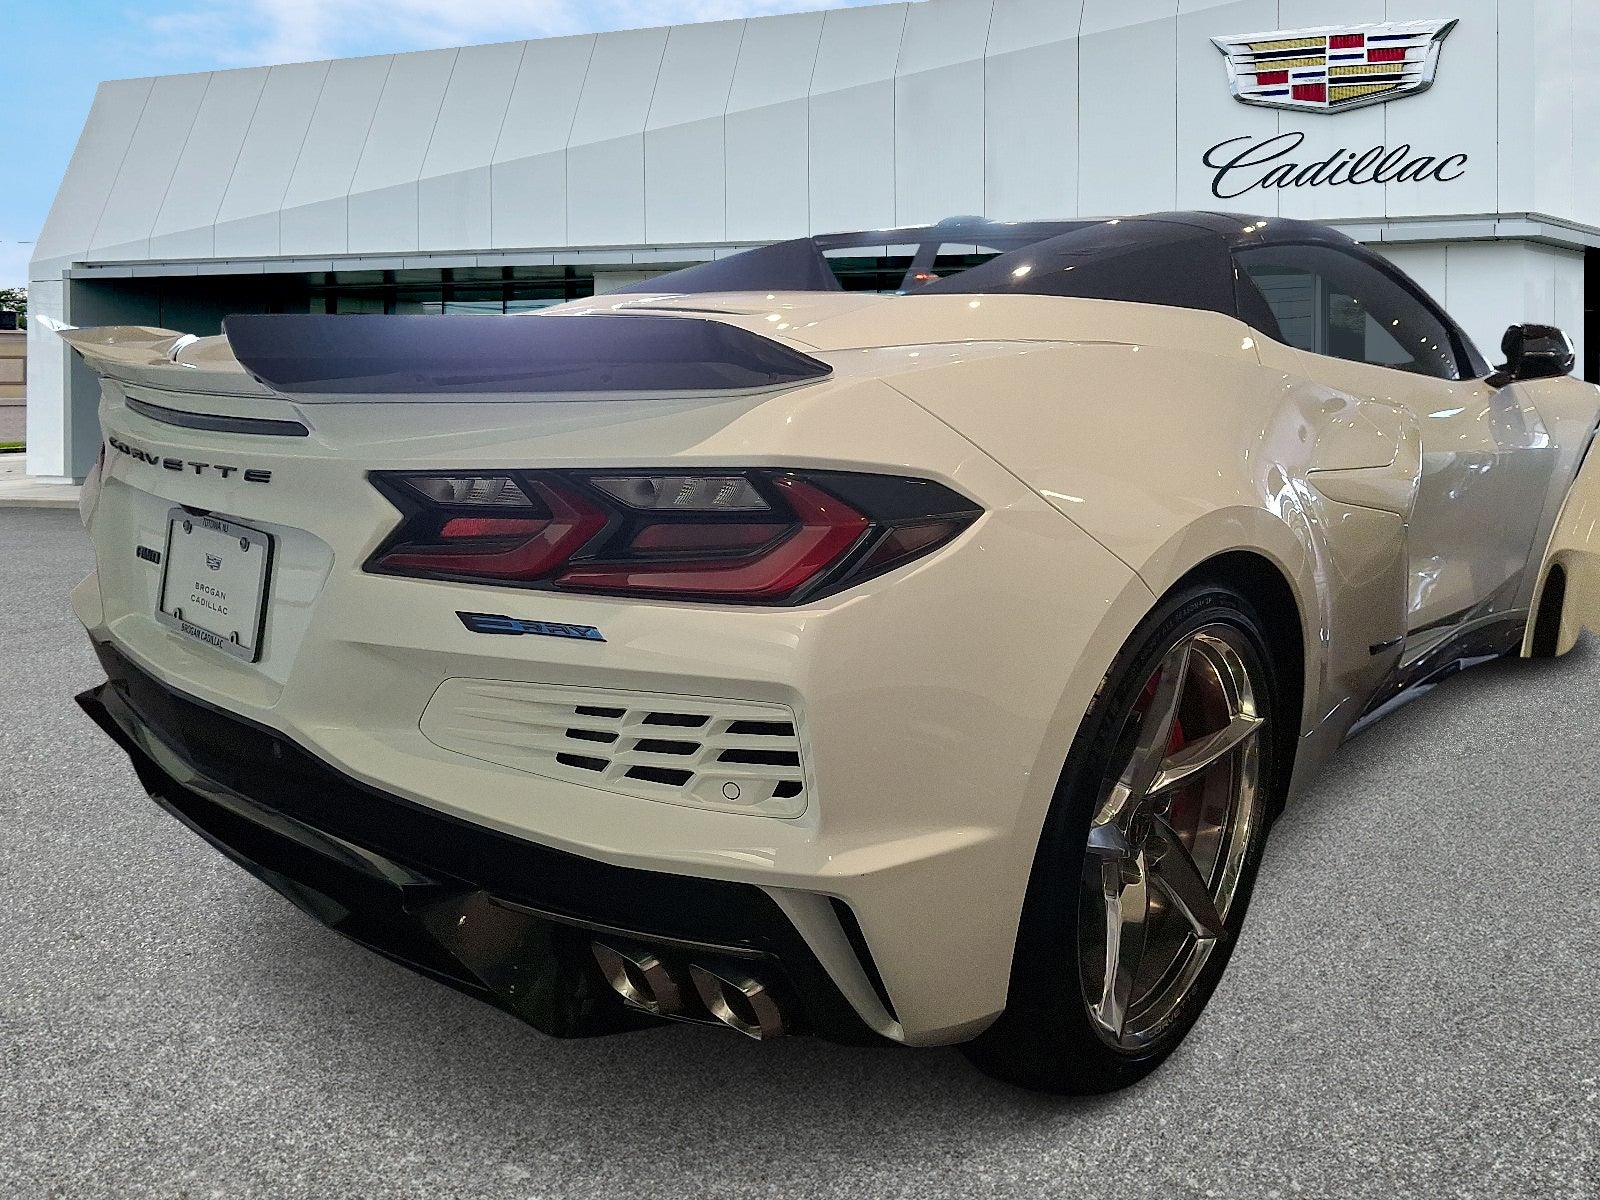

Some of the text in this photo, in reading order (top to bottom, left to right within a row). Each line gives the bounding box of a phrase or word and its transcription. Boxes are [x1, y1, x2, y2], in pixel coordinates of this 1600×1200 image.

[1202, 131, 1468, 199] Cadillac
[108, 435, 273, 484] CORVETTE
[194, 581, 227, 600] BROGAN
[190, 594, 229, 615] CADILLAC
[181, 622, 224, 649] BROGAN CADILLAC
